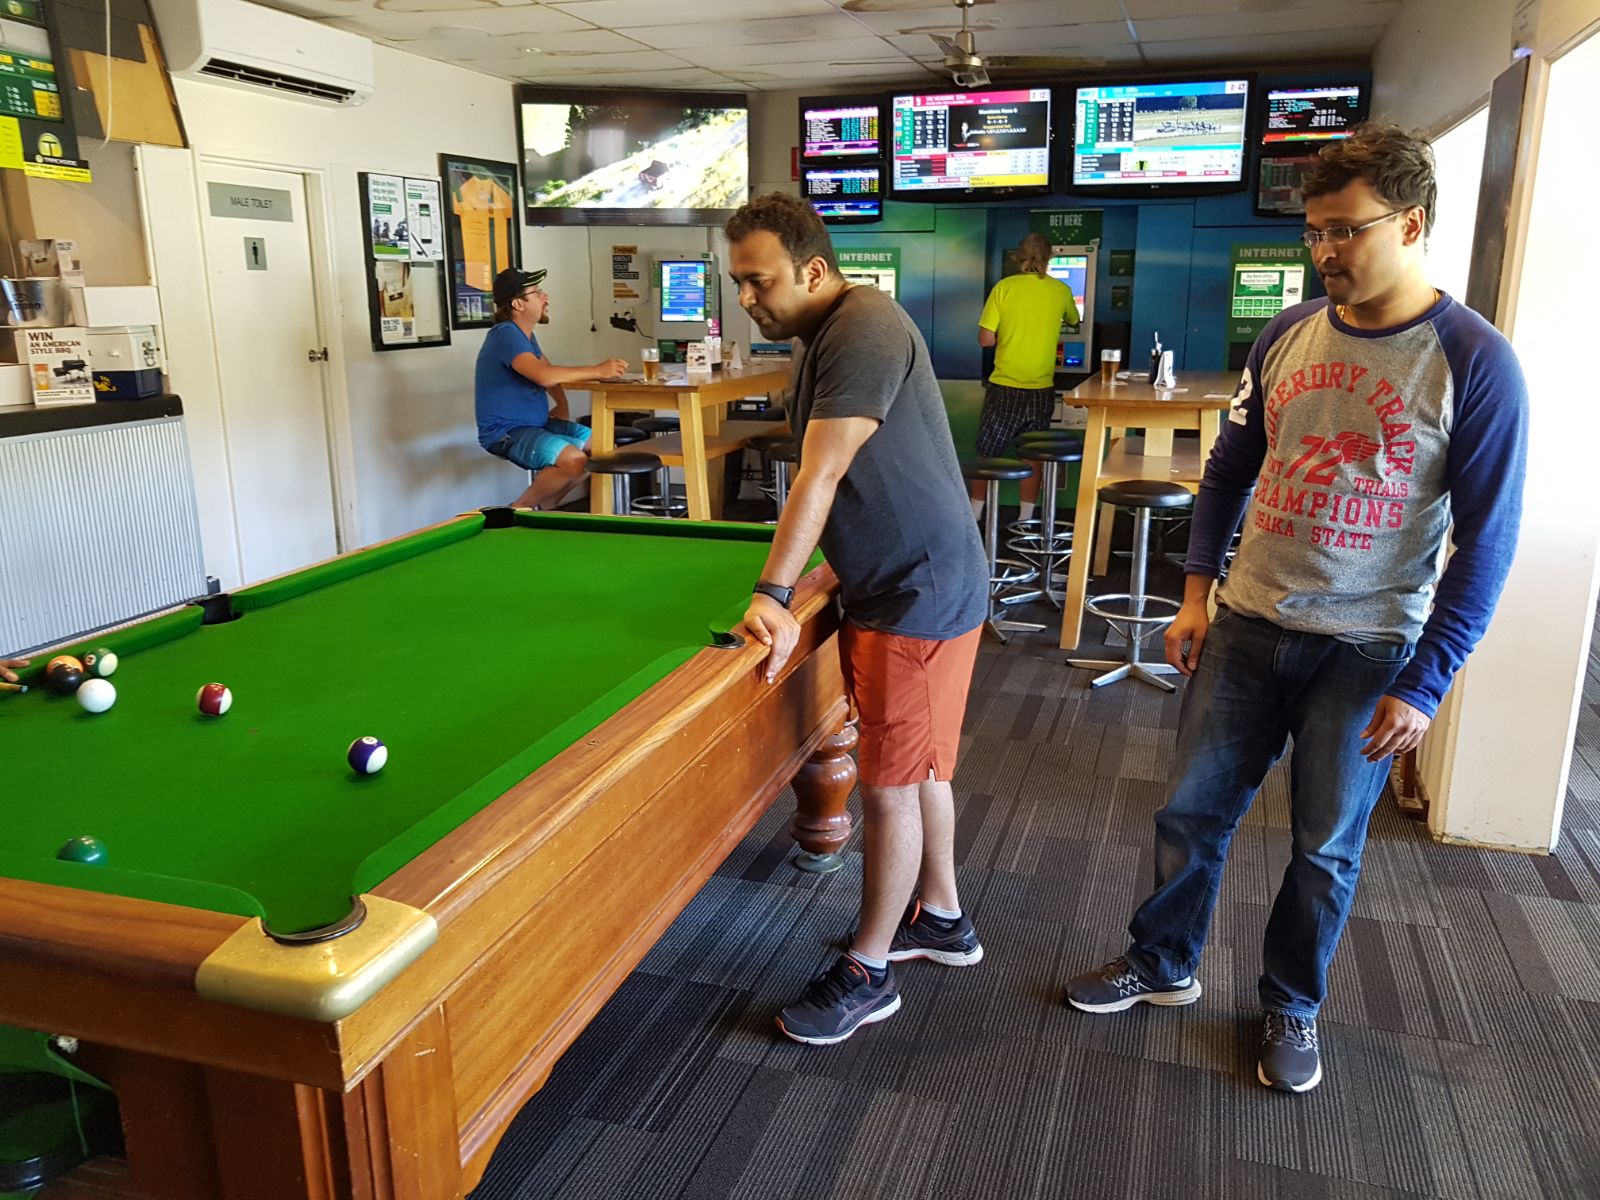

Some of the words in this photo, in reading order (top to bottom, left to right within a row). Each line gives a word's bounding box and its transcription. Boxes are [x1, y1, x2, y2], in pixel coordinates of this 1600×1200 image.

[230, 196, 250, 208] MALE
[250, 198, 273, 210] TOILET
[1050, 214, 1063, 227] BET
[1064, 213, 1083, 226] HERE
[839, 253, 892, 261] INTERNET
[1239, 247, 1303, 258] INTERNET
[1236, 325, 1253, 334] tab
[28, 331, 54, 341] WIN
[42, 339, 82, 348] AMERICAN
[30, 347, 53, 355] STYLE
[54, 347, 72, 355] BBQ
[1365, 378, 1415, 476] TRACK
[1283, 434, 1345, 487] 72
[1353, 476, 1409, 499] TRIALS
[1254, 510, 1295, 538] OSAKA
[1311, 527, 1372, 549] STATE
